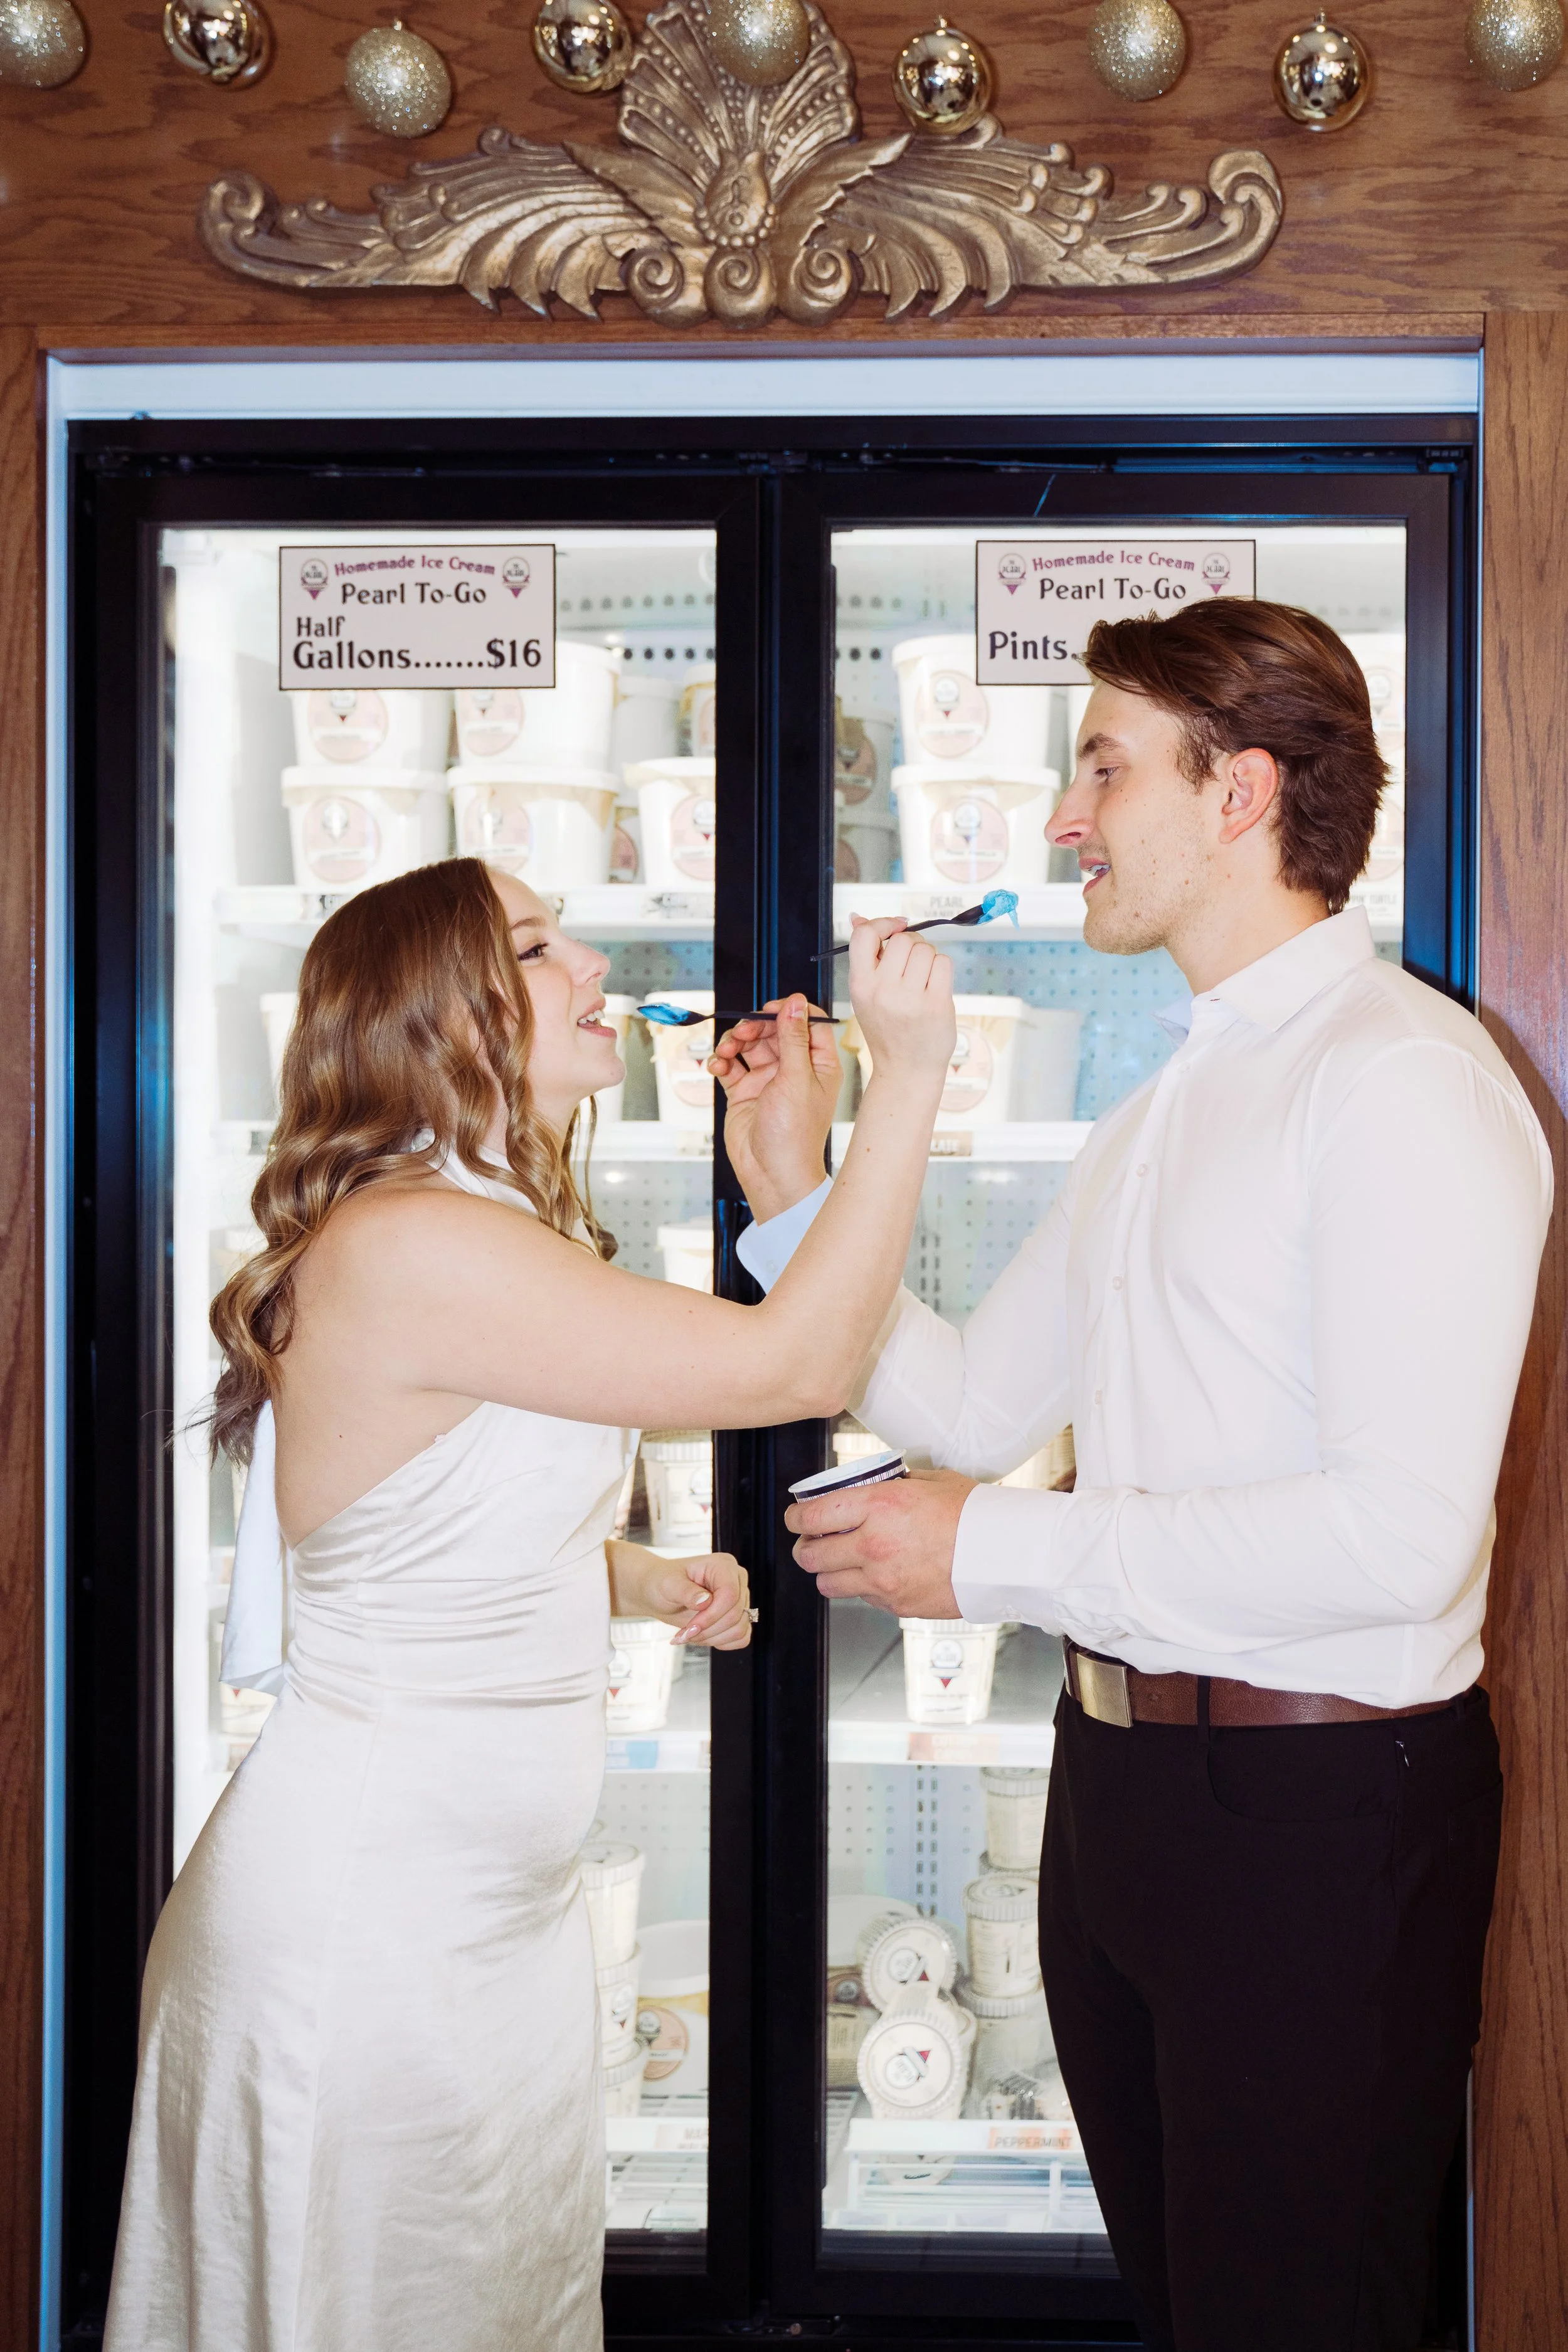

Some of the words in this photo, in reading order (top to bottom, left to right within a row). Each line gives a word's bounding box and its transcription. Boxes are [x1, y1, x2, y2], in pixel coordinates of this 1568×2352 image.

[334, 555, 416, 577] Homemade
[421, 554, 444, 569] Ice
[448, 556, 495, 576] Cream
[1032, 550, 1115, 571] Homemade
[1120, 549, 1143, 564] Ice
[1148, 551, 1195, 571] Cream
[341, 582, 406, 605] Pearl
[415, 581, 487, 604] To-Go
[1039, 578, 1104, 600] Pearl
[1113, 577, 1187, 600] To-Go
[296, 615, 346, 637] Half
[930, 896, 964, 908] PEARL
[995, 2136, 1072, 2148] PEPPERMINT
